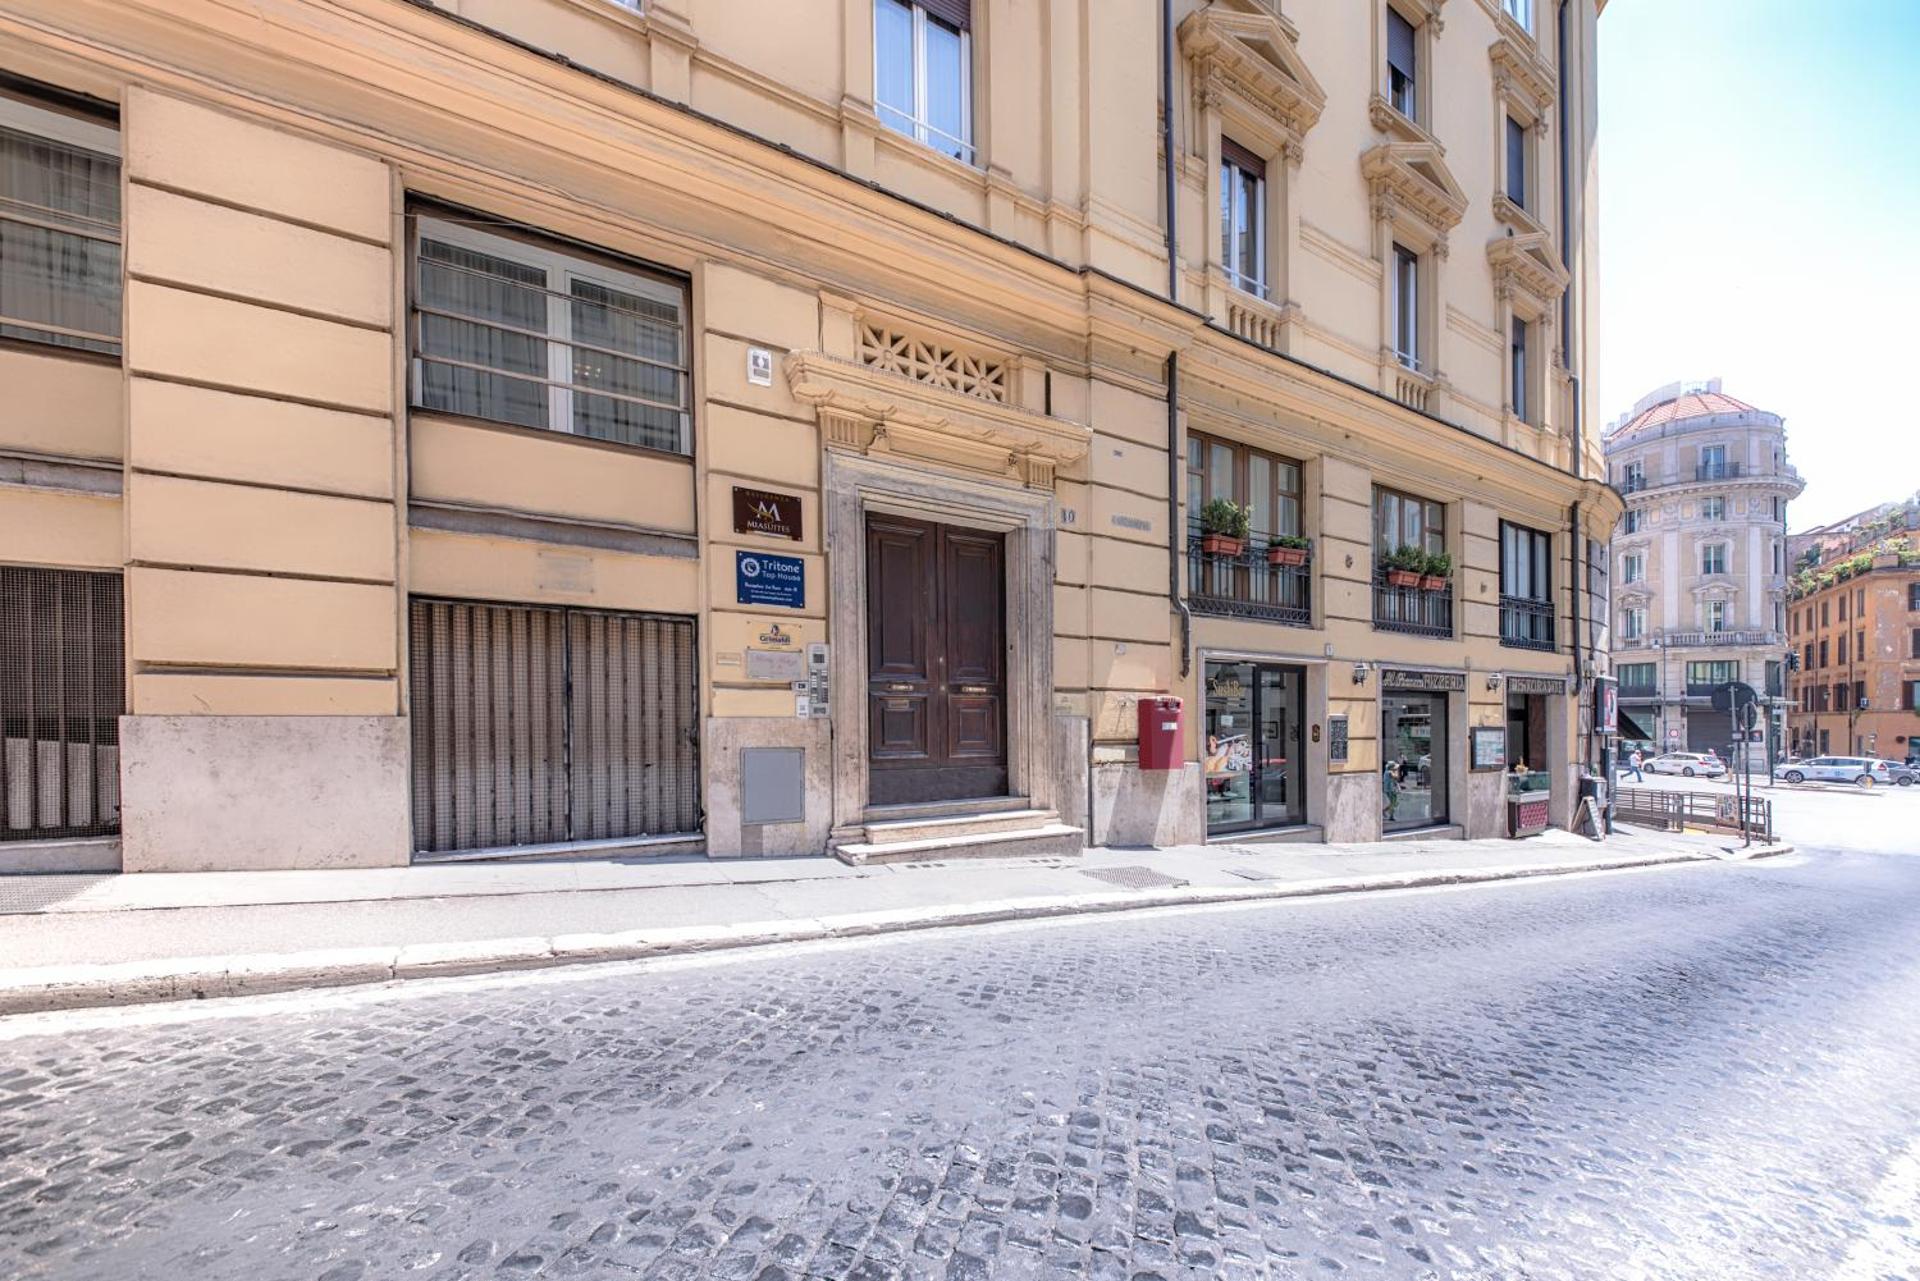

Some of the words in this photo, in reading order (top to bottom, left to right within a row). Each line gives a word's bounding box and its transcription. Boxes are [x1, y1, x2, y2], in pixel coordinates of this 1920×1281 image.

[762, 560, 800, 573] Tritone
[762, 570, 777, 580] Top
[778, 573, 801, 582] House
[1424, 674, 1465, 690] PIZZERIA
